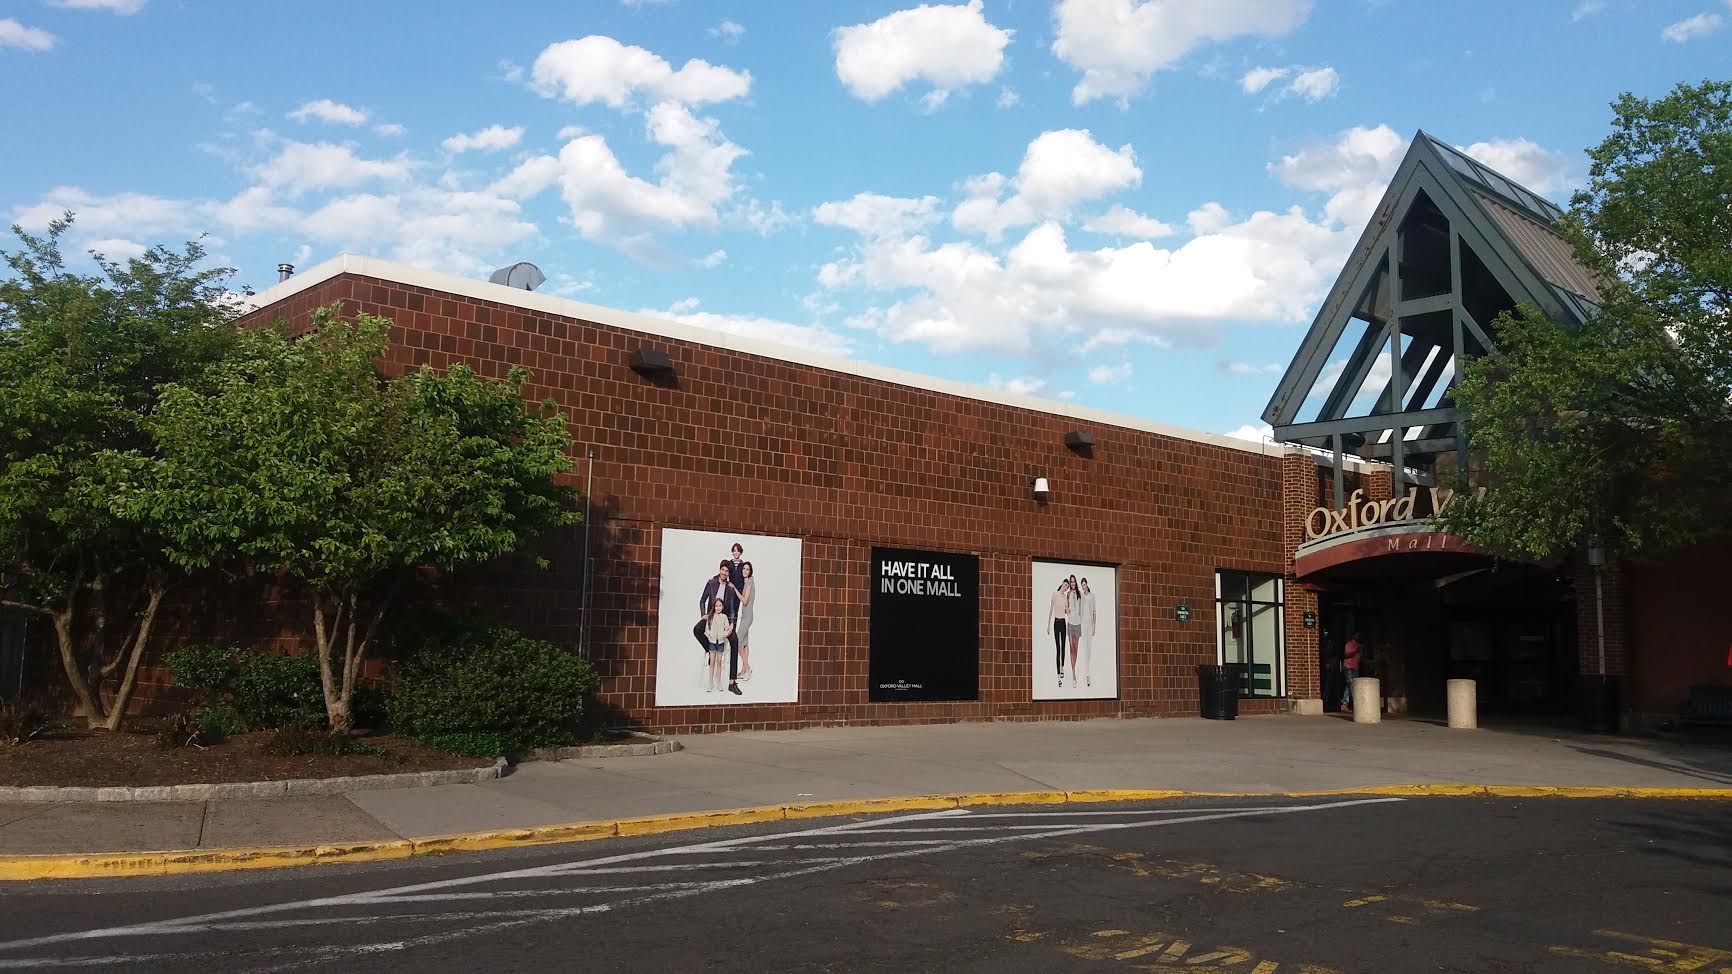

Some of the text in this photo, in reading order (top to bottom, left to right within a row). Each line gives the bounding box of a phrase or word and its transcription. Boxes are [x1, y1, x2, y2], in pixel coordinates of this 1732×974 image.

[1305, 487, 1417, 538] Oxford
[1388, 536, 1447, 551] Mall
[881, 560, 954, 580] HAVE IT ALL
[881, 578, 961, 597] IN ONE MALL
